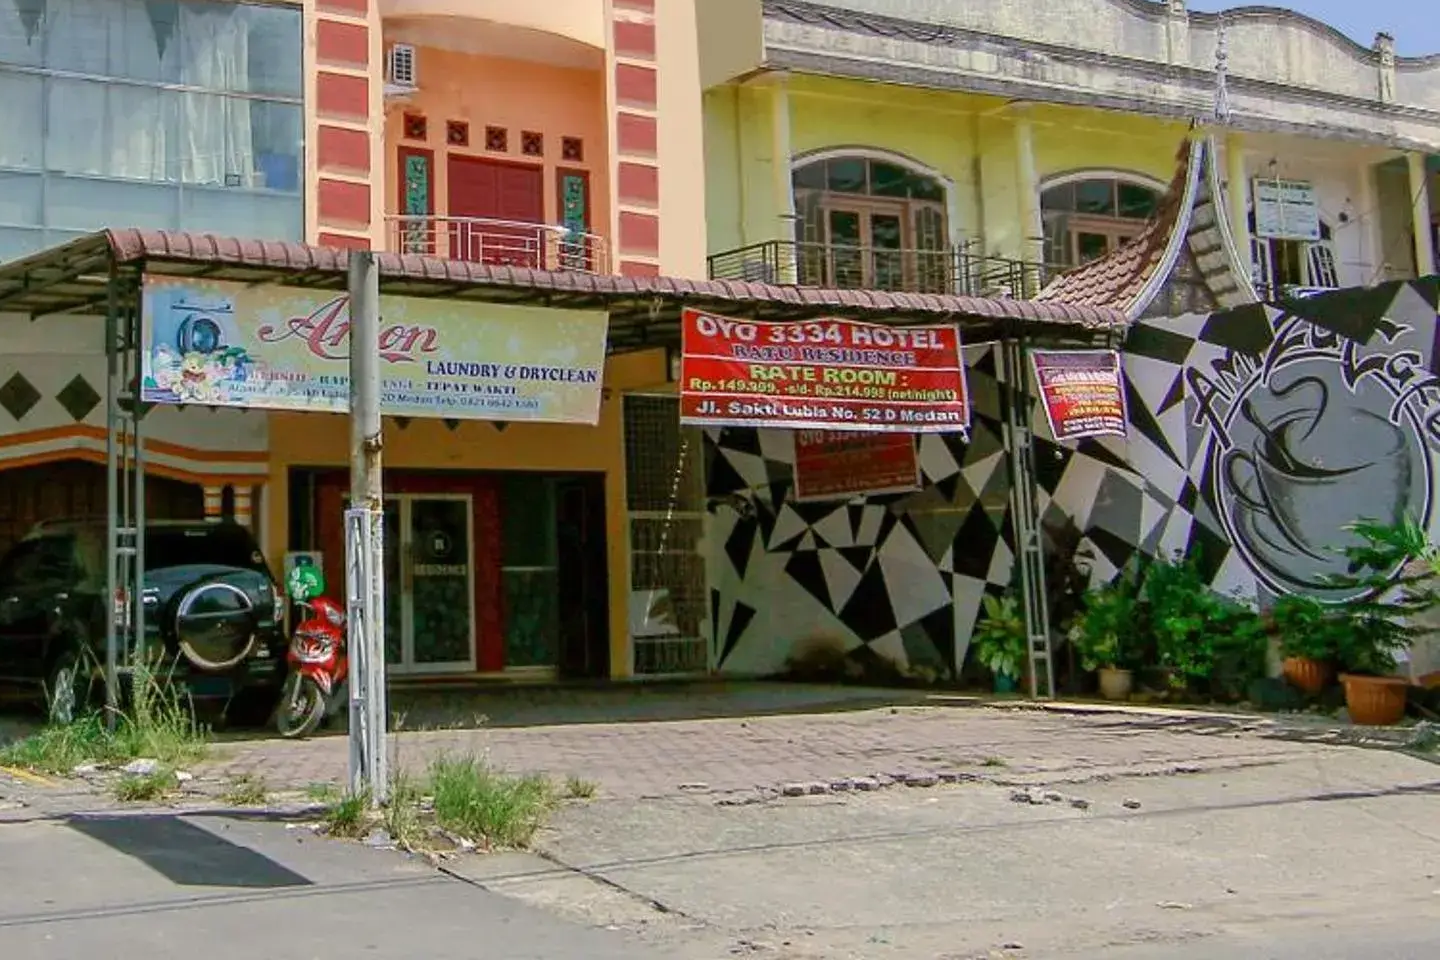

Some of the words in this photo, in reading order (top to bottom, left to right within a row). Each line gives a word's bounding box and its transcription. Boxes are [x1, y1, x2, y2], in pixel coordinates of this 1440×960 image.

[696, 315, 757, 341] OYO
[768, 323, 843, 343] 3334
[851, 326, 944, 349] HOTEL
[799, 345, 917, 365] RESIDENCE
[427, 360, 499, 379] LAUNDRY
[504, 365, 518, 379] &
[520, 366, 598, 383] DRYCLEAN
[748, 364, 817, 381] RATE
[823, 368, 896, 386] ROOM
[728, 401, 778, 415] Sakti
[832, 407, 857, 419] No.
[863, 408, 881, 420] 52
[885, 408, 896, 420] D
[900, 410, 959, 422] Medan
